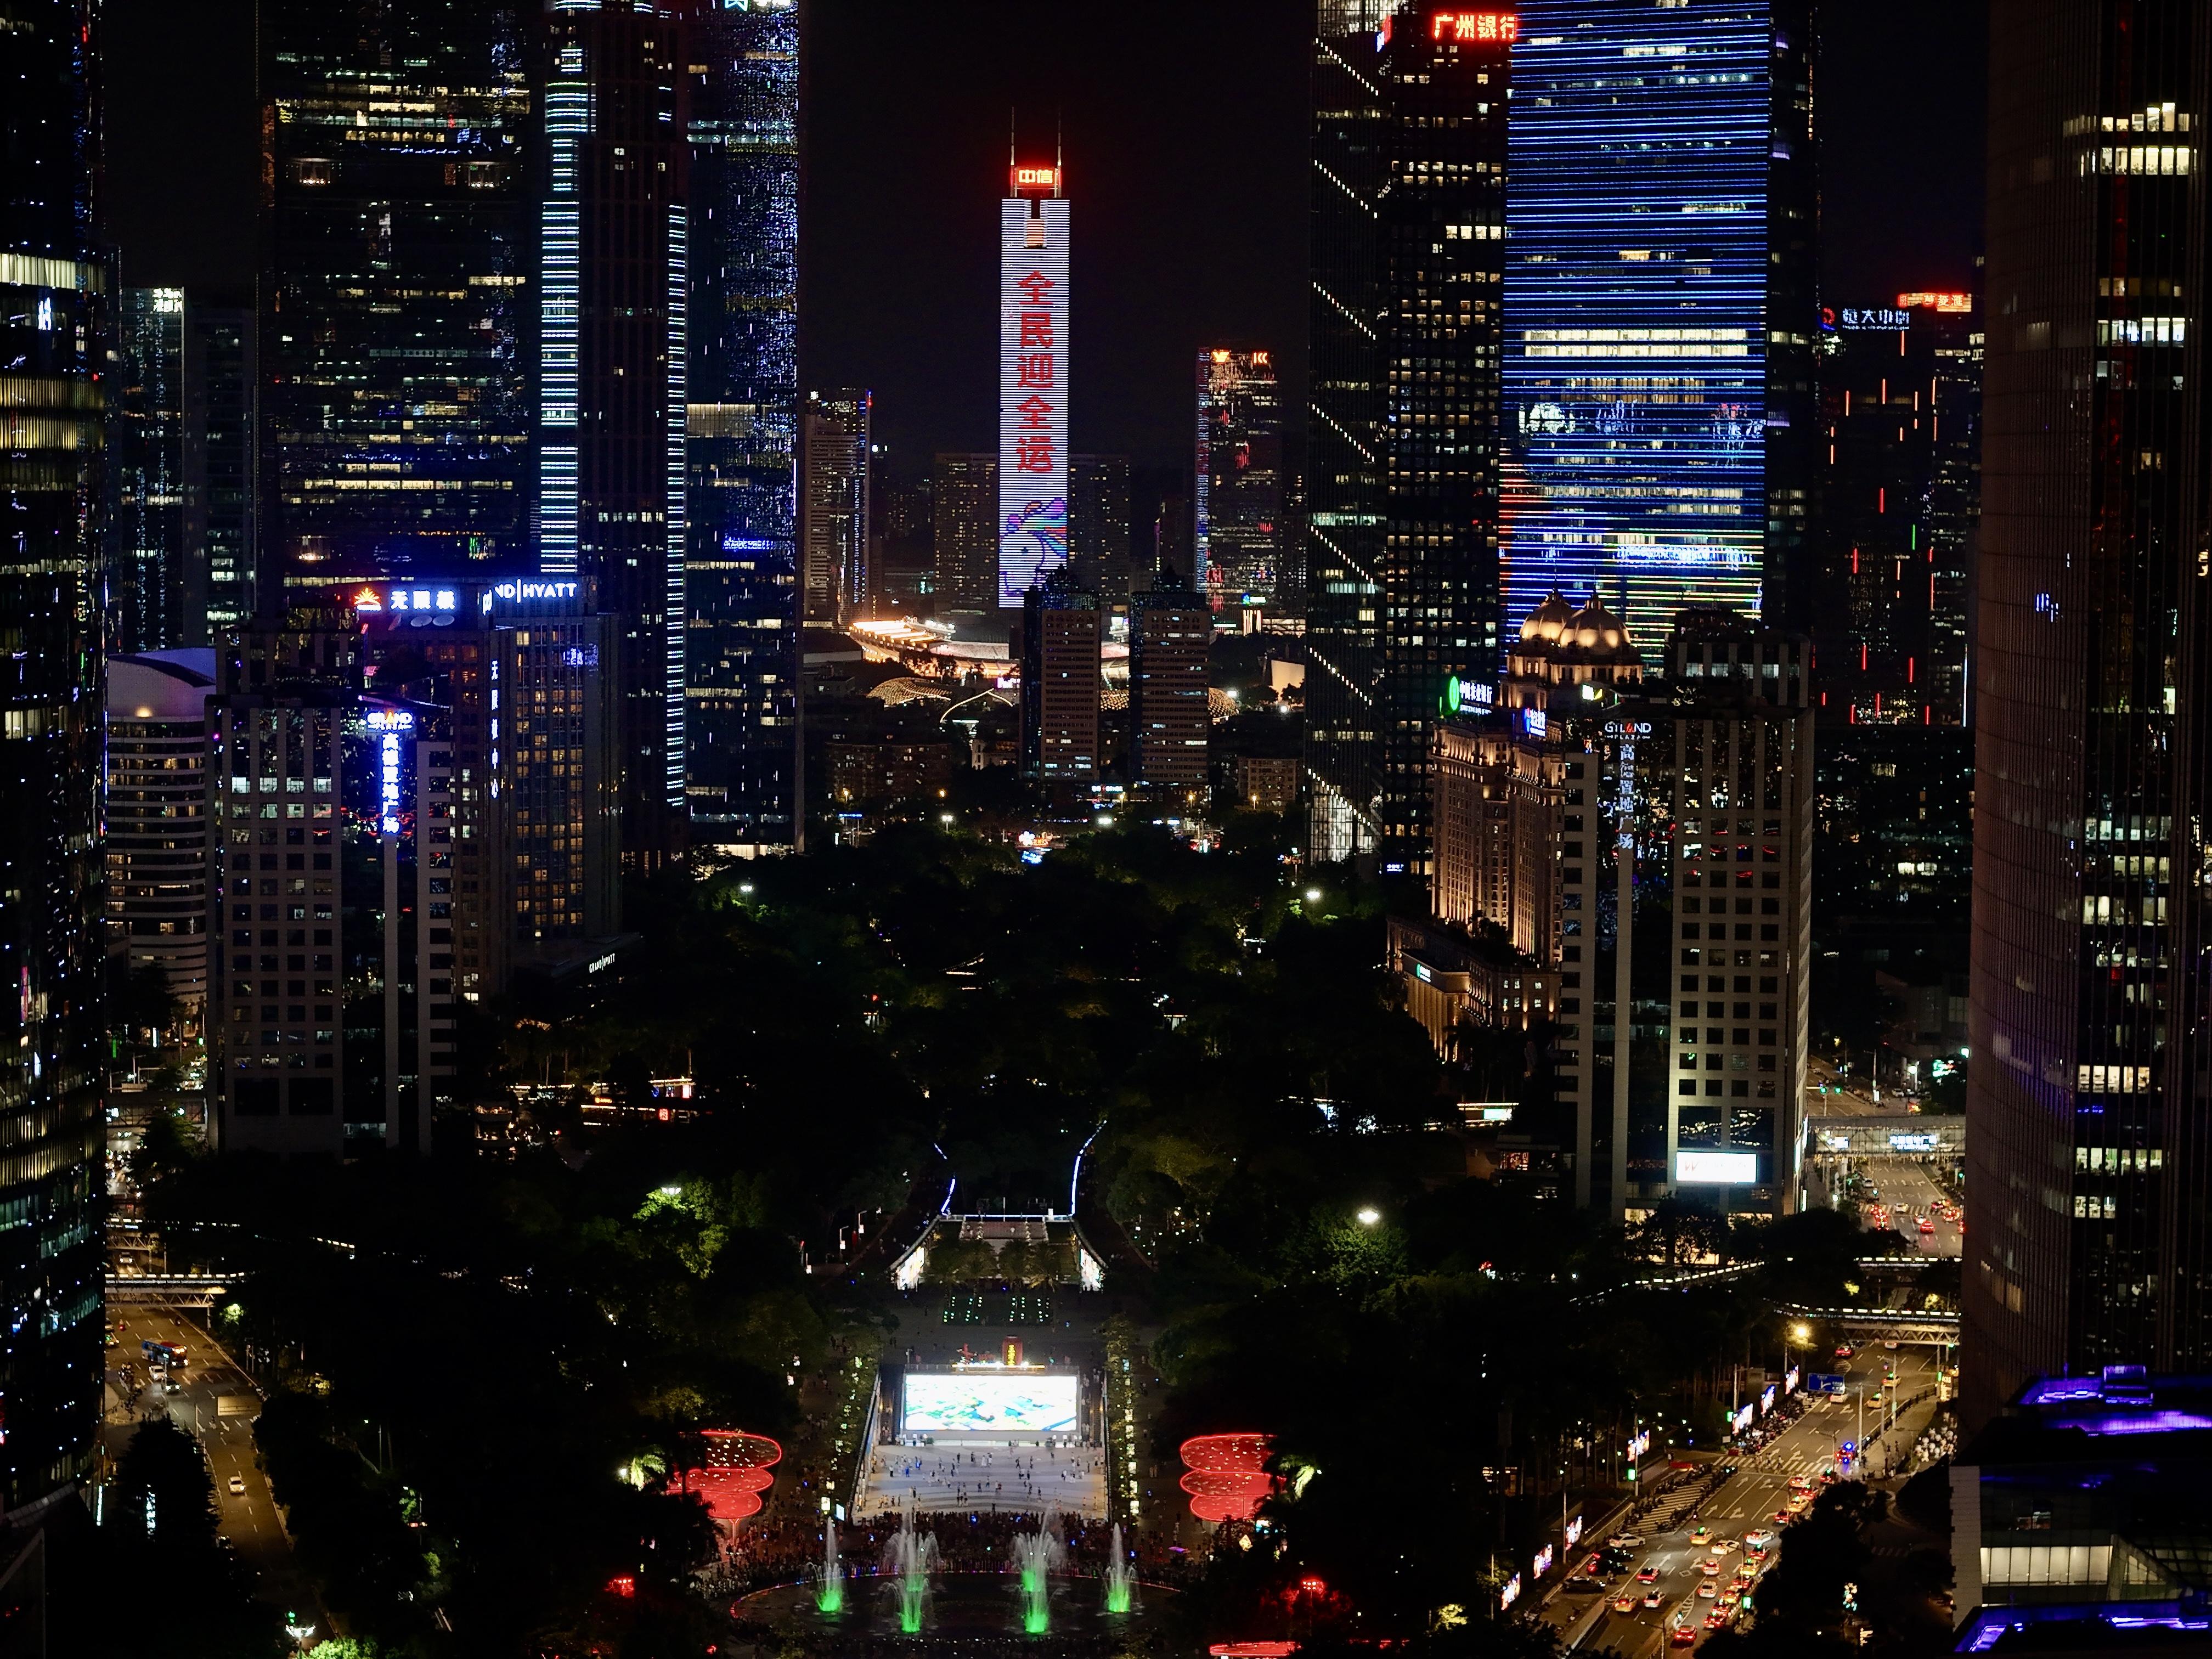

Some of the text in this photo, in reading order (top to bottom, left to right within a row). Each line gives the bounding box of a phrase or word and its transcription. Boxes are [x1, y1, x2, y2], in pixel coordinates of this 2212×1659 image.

[1434, 14, 1515, 39] 广州银行
[1019, 169, 1053, 183] 中信
[1017, 271, 1056, 473] 全民迎全运
[1459, 680, 1492, 703] 中国农业银行
[1619, 744, 1634, 850] 高德置地广场
